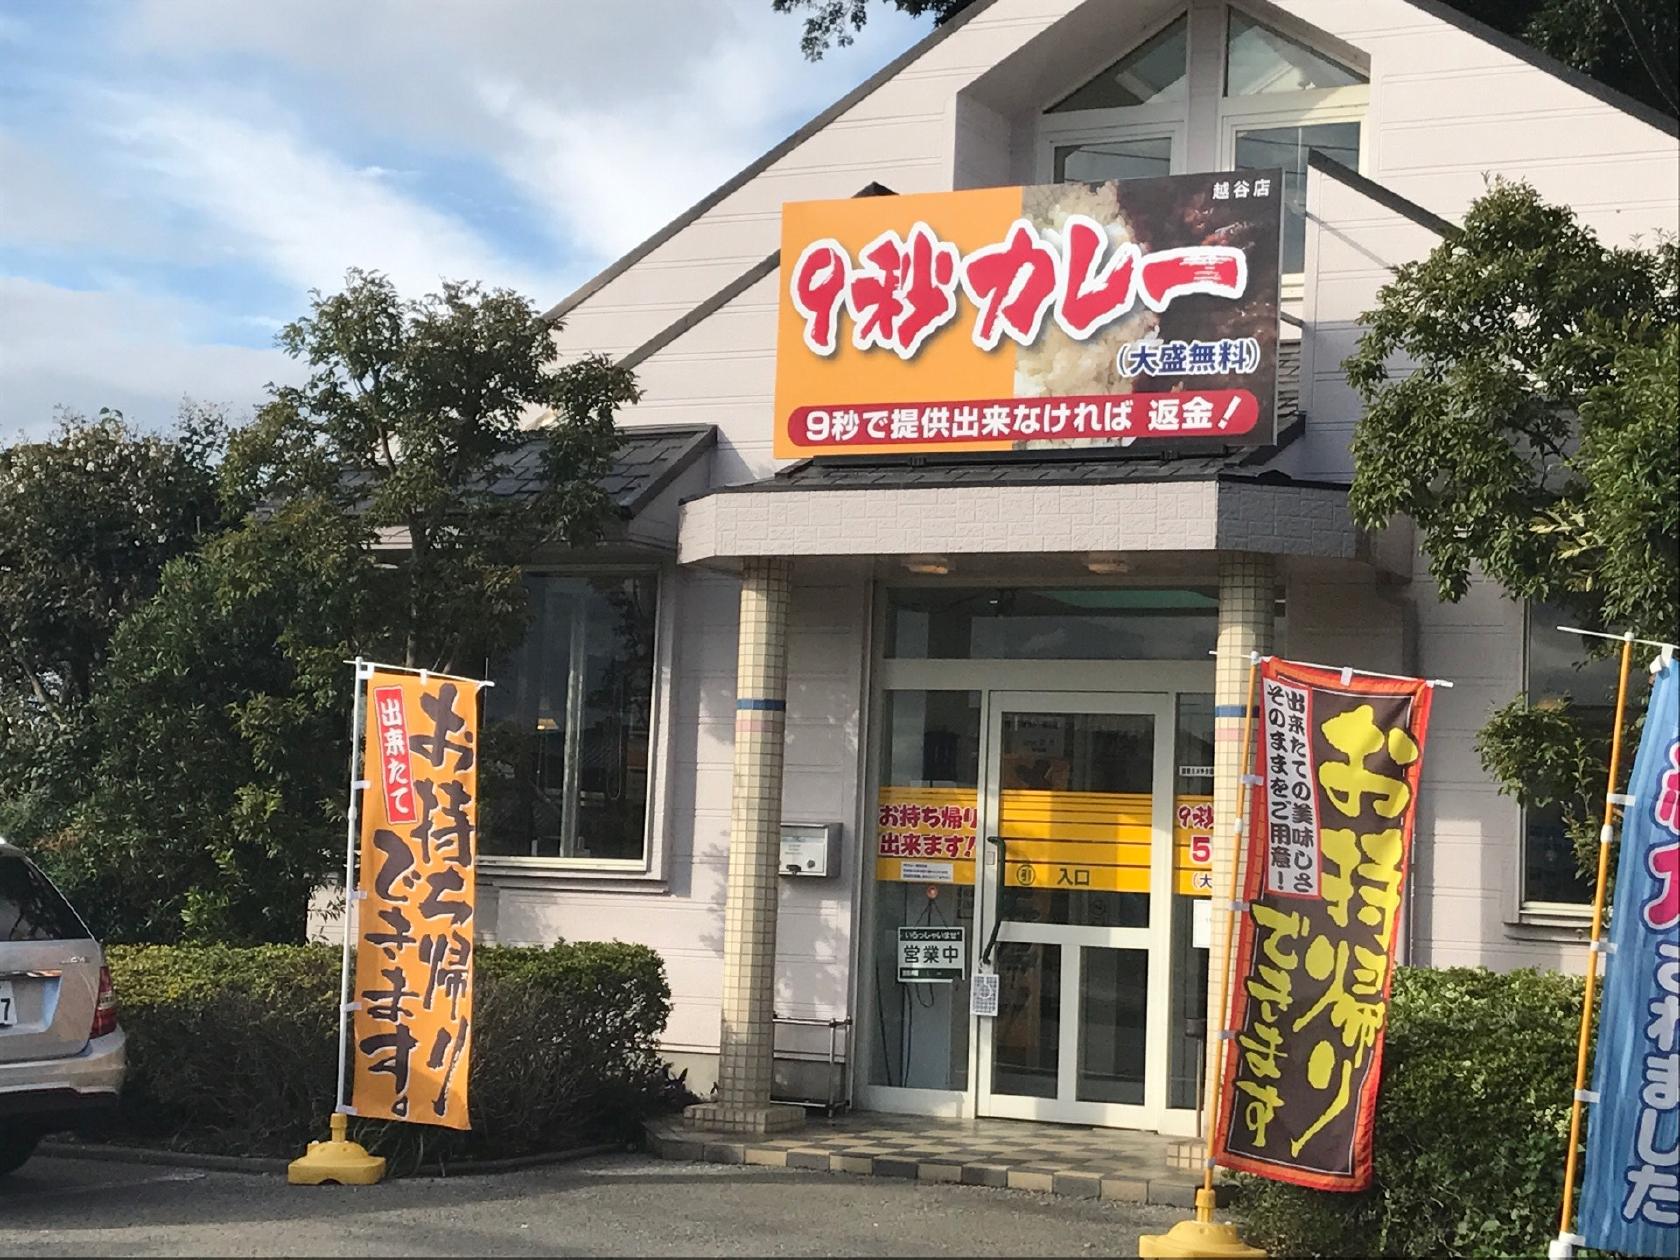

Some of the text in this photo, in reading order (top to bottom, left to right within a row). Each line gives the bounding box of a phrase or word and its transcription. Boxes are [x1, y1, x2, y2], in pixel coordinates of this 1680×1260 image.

[1212, 178, 1271, 200] 越谷店
[806, 399, 1133, 441] 9秒で提供出来なければ
[380, 697, 411, 815] 出来たて
[1286, 690, 1314, 893] 出来たての美味しさ
[879, 804, 977, 829] お持ち帰り
[1057, 868, 1090, 886] 入口
[409, 682, 475, 1118] お持ち帰り
[904, 945, 958, 964] 営業中
[1236, 903, 1310, 1148] できます
